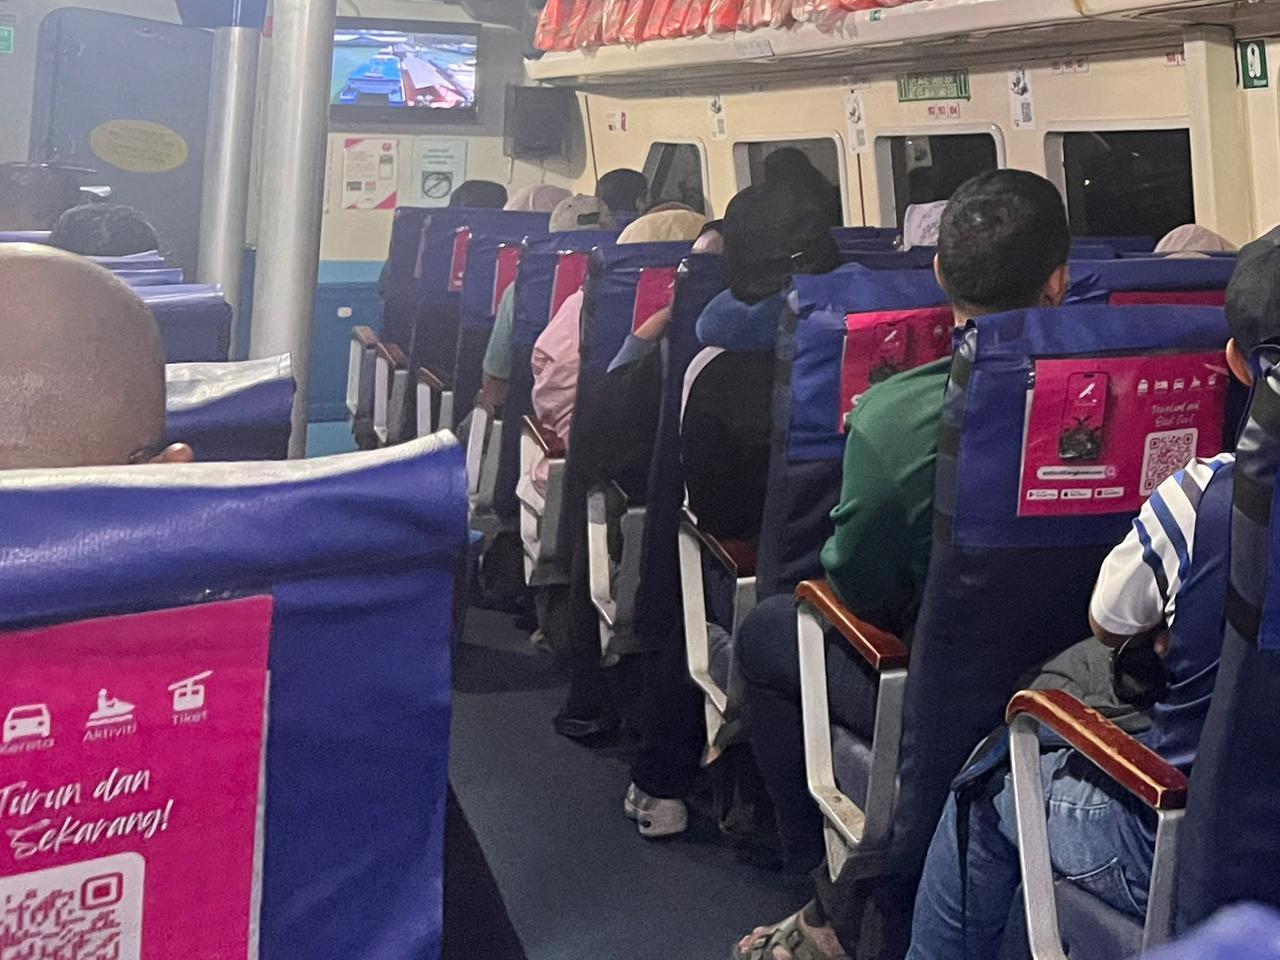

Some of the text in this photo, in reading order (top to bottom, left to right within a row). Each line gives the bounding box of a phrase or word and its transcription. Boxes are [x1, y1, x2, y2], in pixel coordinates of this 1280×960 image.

[83, 724, 137, 742] Aktiviti
[171, 709, 208, 727] Tiket
[0, 767, 151, 816] Turun dan
[6, 799, 174, 858] Sekarang!
